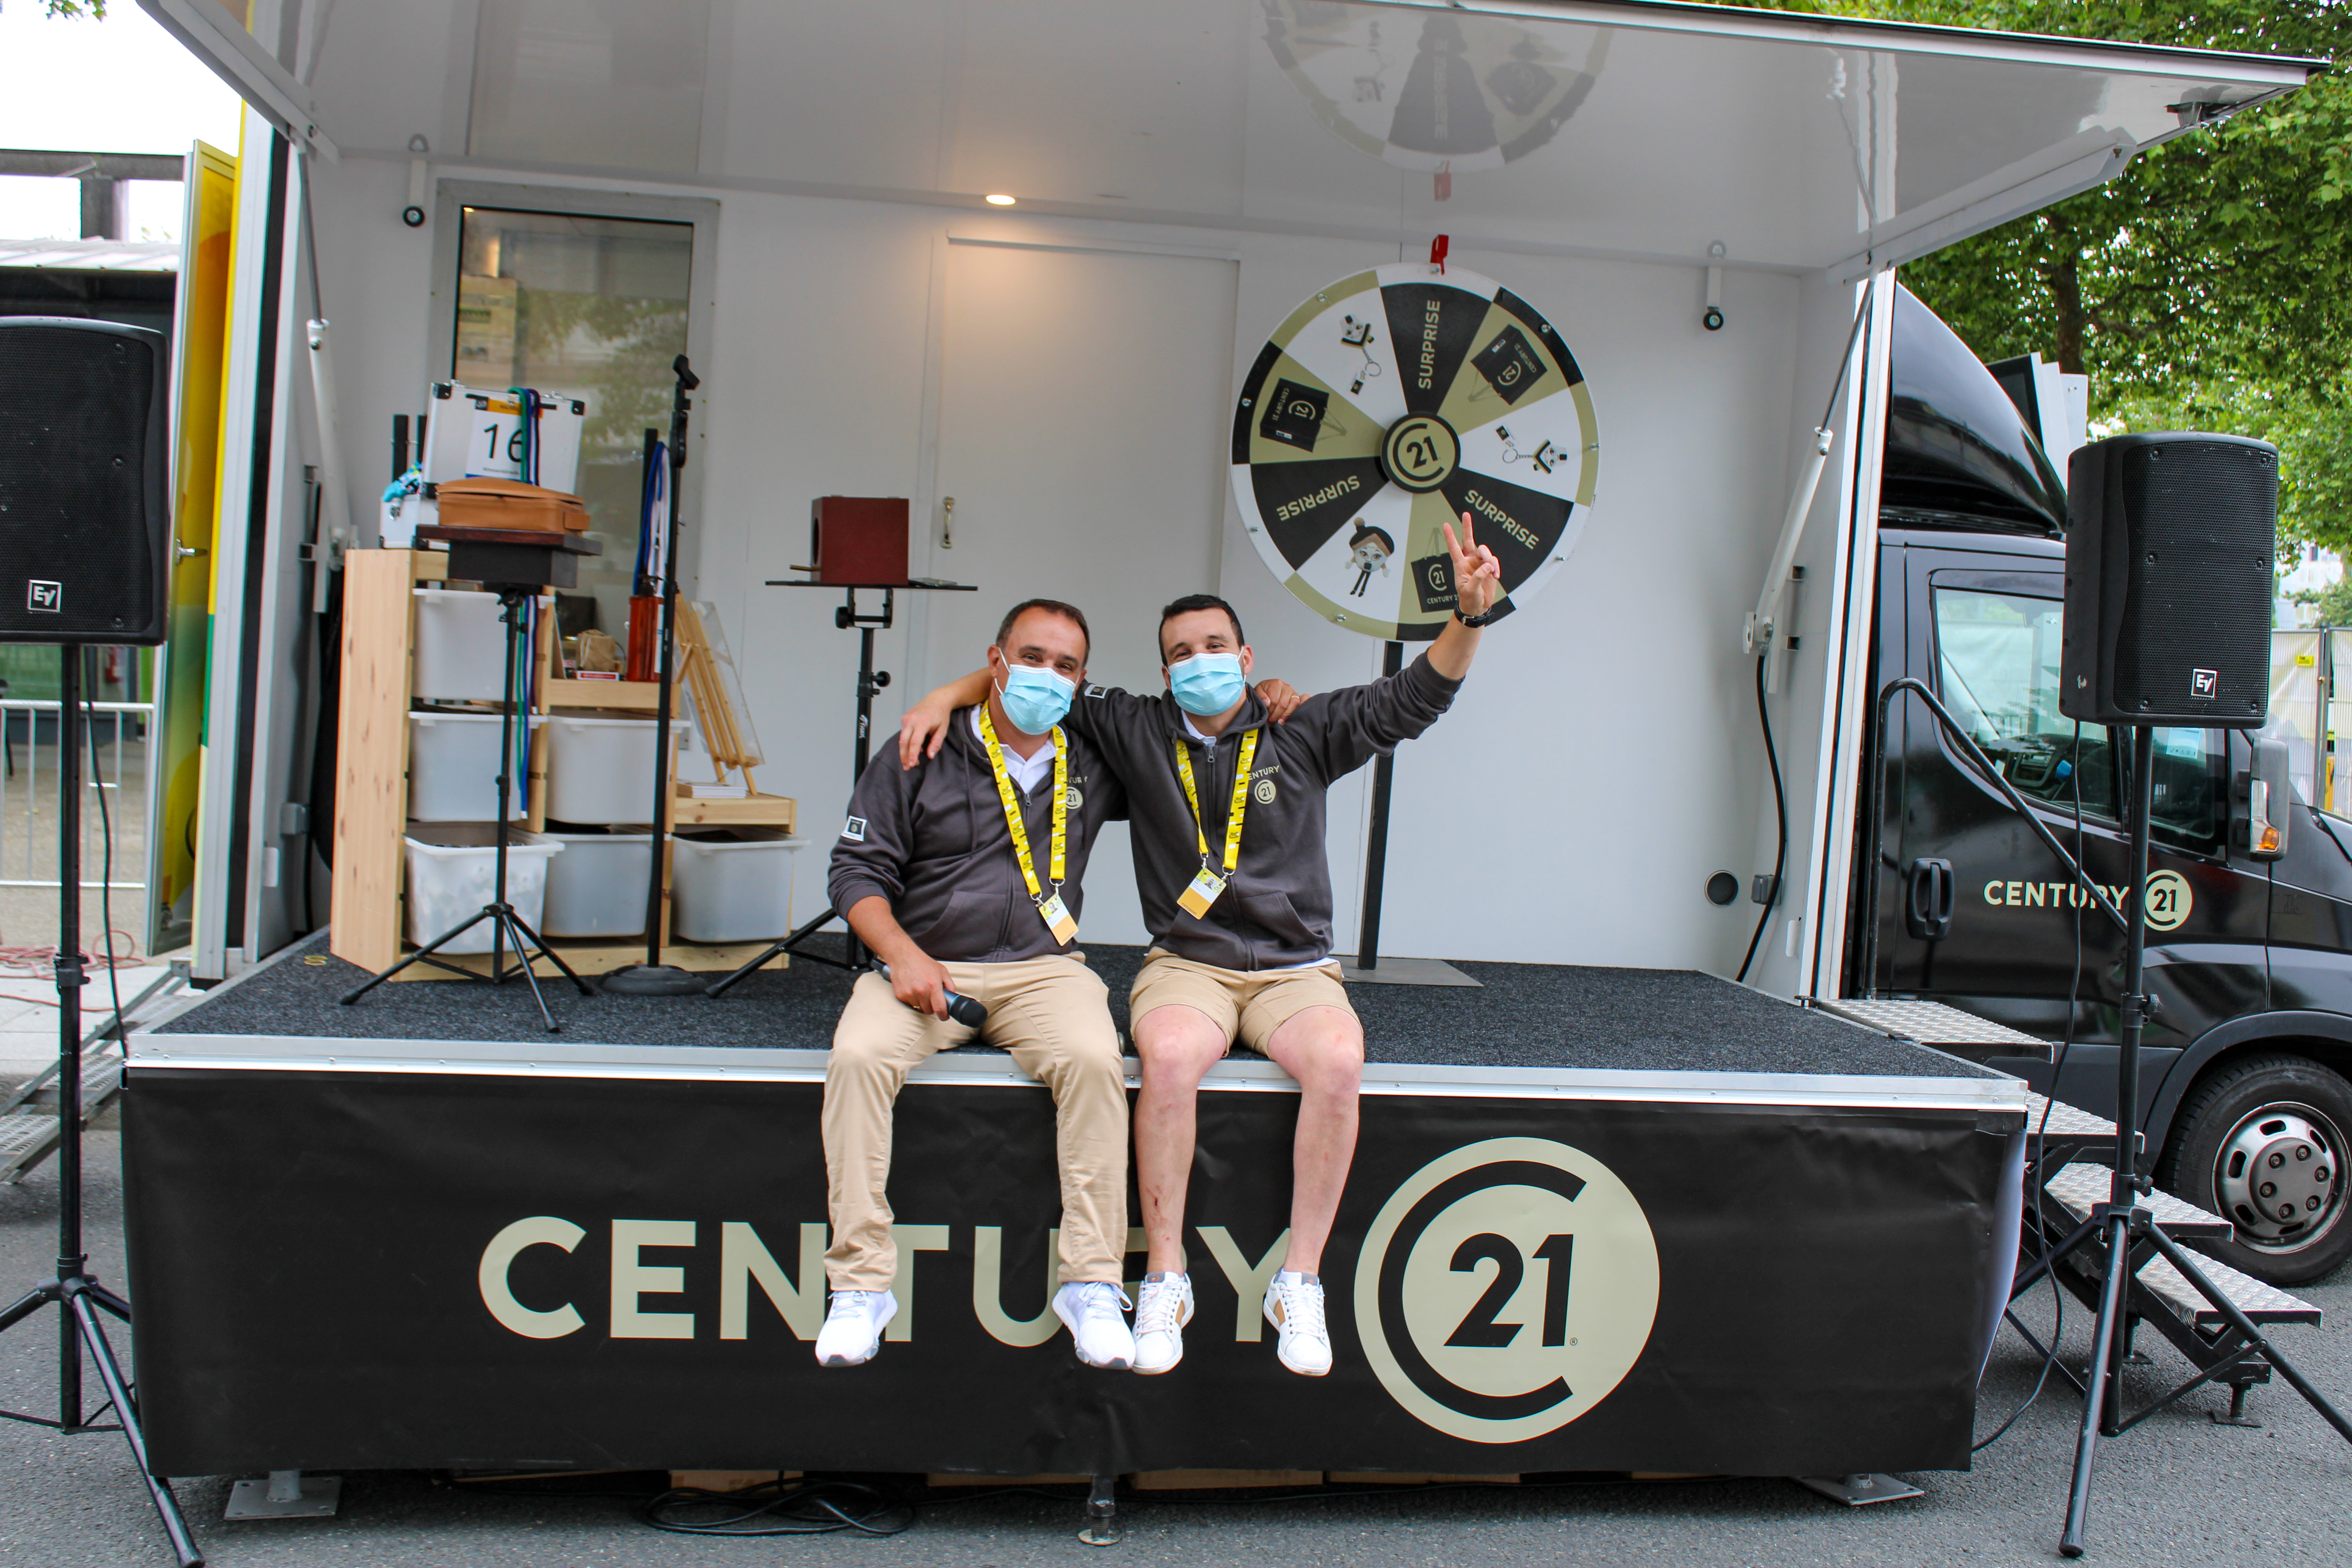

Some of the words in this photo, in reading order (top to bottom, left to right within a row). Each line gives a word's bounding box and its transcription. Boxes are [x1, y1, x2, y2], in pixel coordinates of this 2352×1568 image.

[1418, 300, 1441, 390] SURPRISE
[1502, 365, 1517, 380] 21
[1295, 405, 1309, 418] 21
[1406, 435, 1438, 469] 21
[1276, 475, 1360, 521] SURPRISE
[1464, 488, 1539, 550] SURPRISE
[1433, 570, 1445, 584] 21
[1427, 595, 1453, 604] CENTURY
[1248, 765, 1280, 780] ENTURY
[1067, 794, 1076, 802] 21
[1261, 786, 1271, 797] 21
[2152, 889, 2177, 912] 21
[479, 1216, 1290, 1347] CENTUY
[1443, 1232, 1574, 1348] 21
